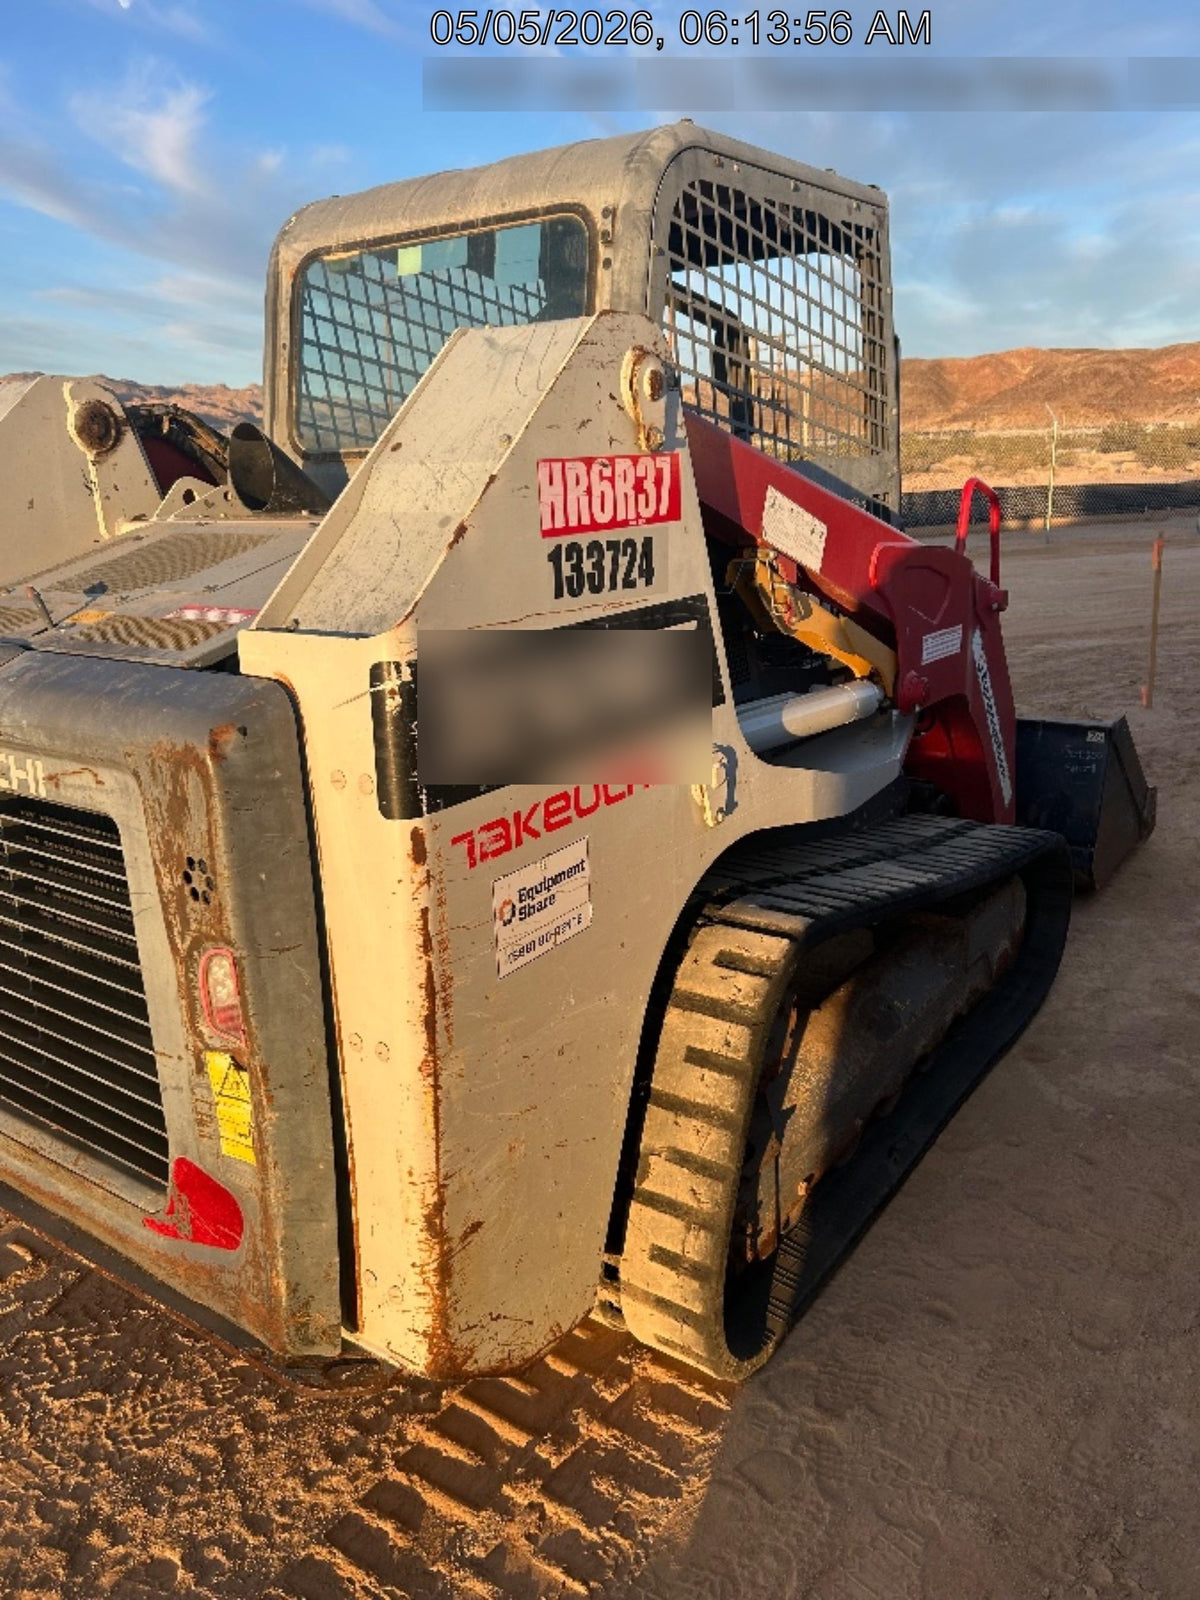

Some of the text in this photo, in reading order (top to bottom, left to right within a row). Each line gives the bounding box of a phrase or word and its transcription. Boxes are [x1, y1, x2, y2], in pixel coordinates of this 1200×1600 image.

[537, 456, 671, 531] HR6R37
[547, 536, 655, 600] 133724
[518, 858, 586, 904] Equipment
[518, 894, 556, 921] Share
